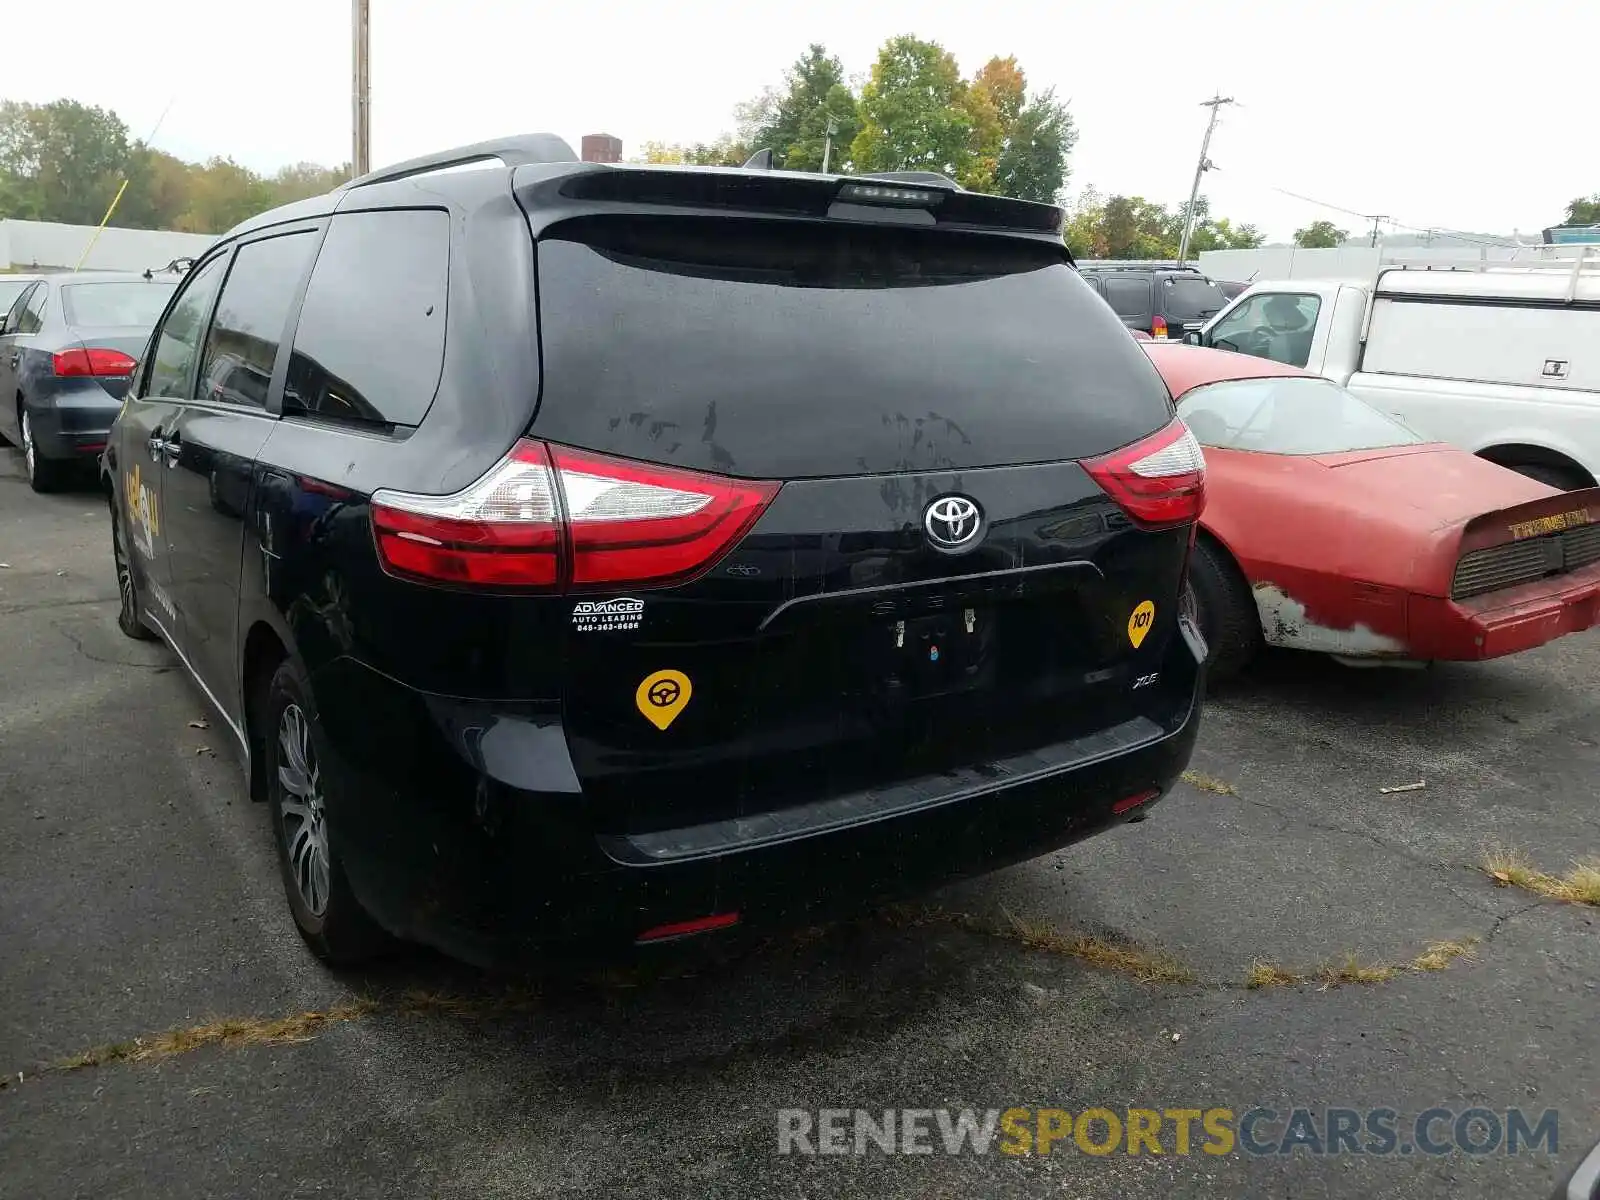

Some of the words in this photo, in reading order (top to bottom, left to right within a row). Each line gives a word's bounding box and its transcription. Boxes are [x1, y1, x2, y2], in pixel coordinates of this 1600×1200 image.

[573, 601, 644, 614] ADVANCED
[601, 613, 643, 623] LEASING
[1133, 611, 1151, 629] 101
[1132, 672, 1159, 690] XLE
